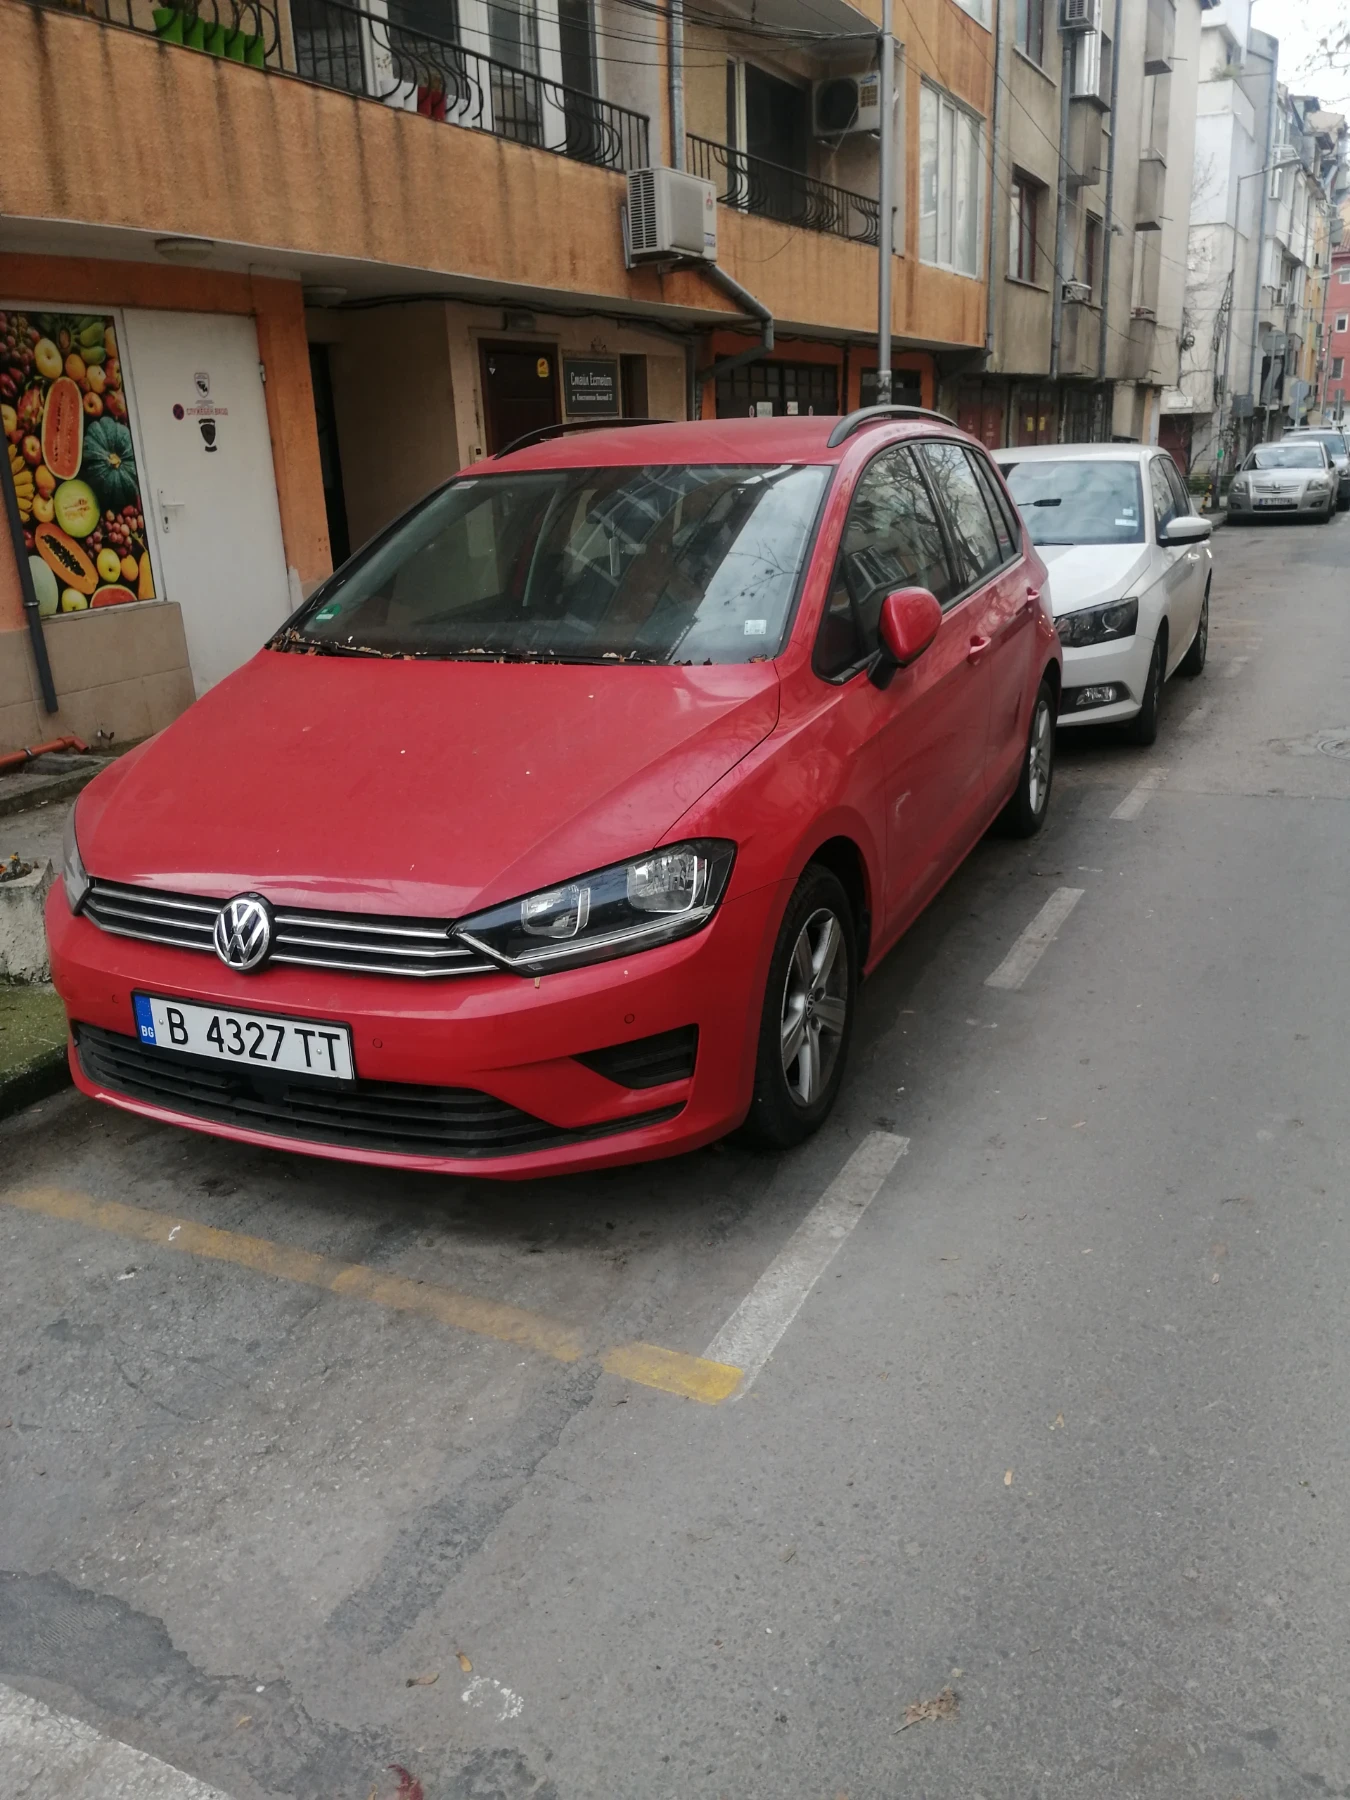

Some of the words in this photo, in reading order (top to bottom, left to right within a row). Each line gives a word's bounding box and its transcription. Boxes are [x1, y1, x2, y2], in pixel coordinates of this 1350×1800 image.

[571, 372, 589, 386] Смайл
[590, 372, 612, 386] Естейт
[141, 1025, 155, 1039] BG
[166, 1006, 189, 1045] B
[206, 1015, 286, 1062] 4327
[293, 1027, 341, 1072] TT
